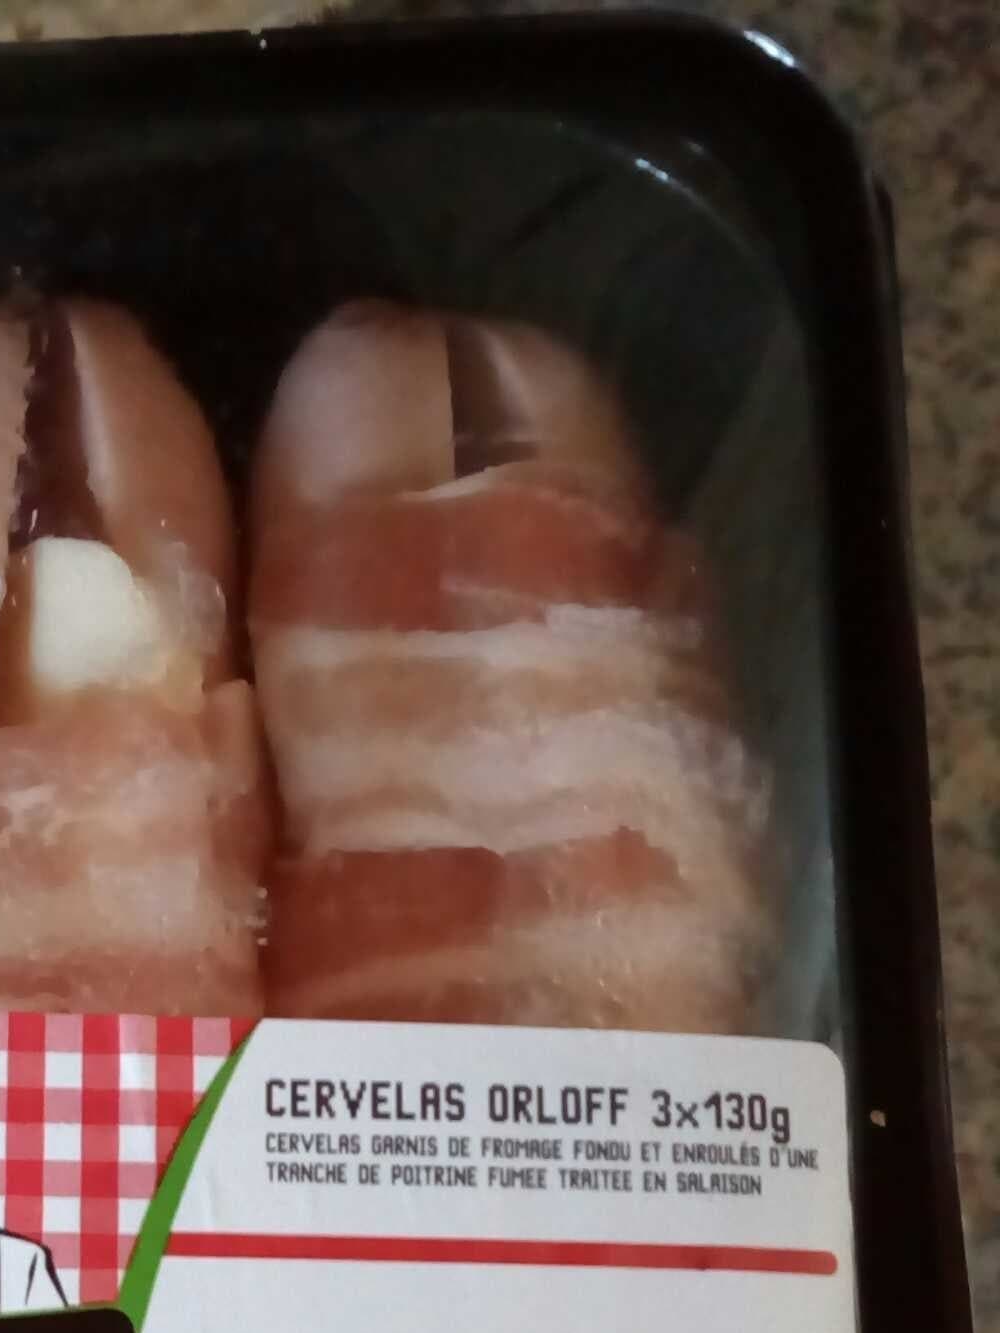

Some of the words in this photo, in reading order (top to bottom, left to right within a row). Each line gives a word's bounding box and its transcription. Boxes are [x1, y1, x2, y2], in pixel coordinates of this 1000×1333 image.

[265, 1079, 466, 1122] CERVELAS
[487, 1084, 629, 1126] ORLOFF
[651, 1090, 791, 1144] 3x130g
[265, 1135, 362, 1157] CERVELAS
[370, 1137, 439, 1159] GARNIS
[447, 1139, 471, 1159] DE
[480, 1140, 563, 1161] FROMAGE
[572, 1142, 632, 1163] FONDU
[639, 1143, 662, 1164] ET
[266, 1164, 348, 1185] TRANCHE
[357, 1166, 381, 1185] DE
[390, 1167, 478, 1188] POITRINE
[487, 1169, 547, 1190] FUMEE
[559, 1171, 633, 1192] TRAITEE
[642, 1173, 667, 1193] EN
[676, 1174, 763, 1195] SALAISON
